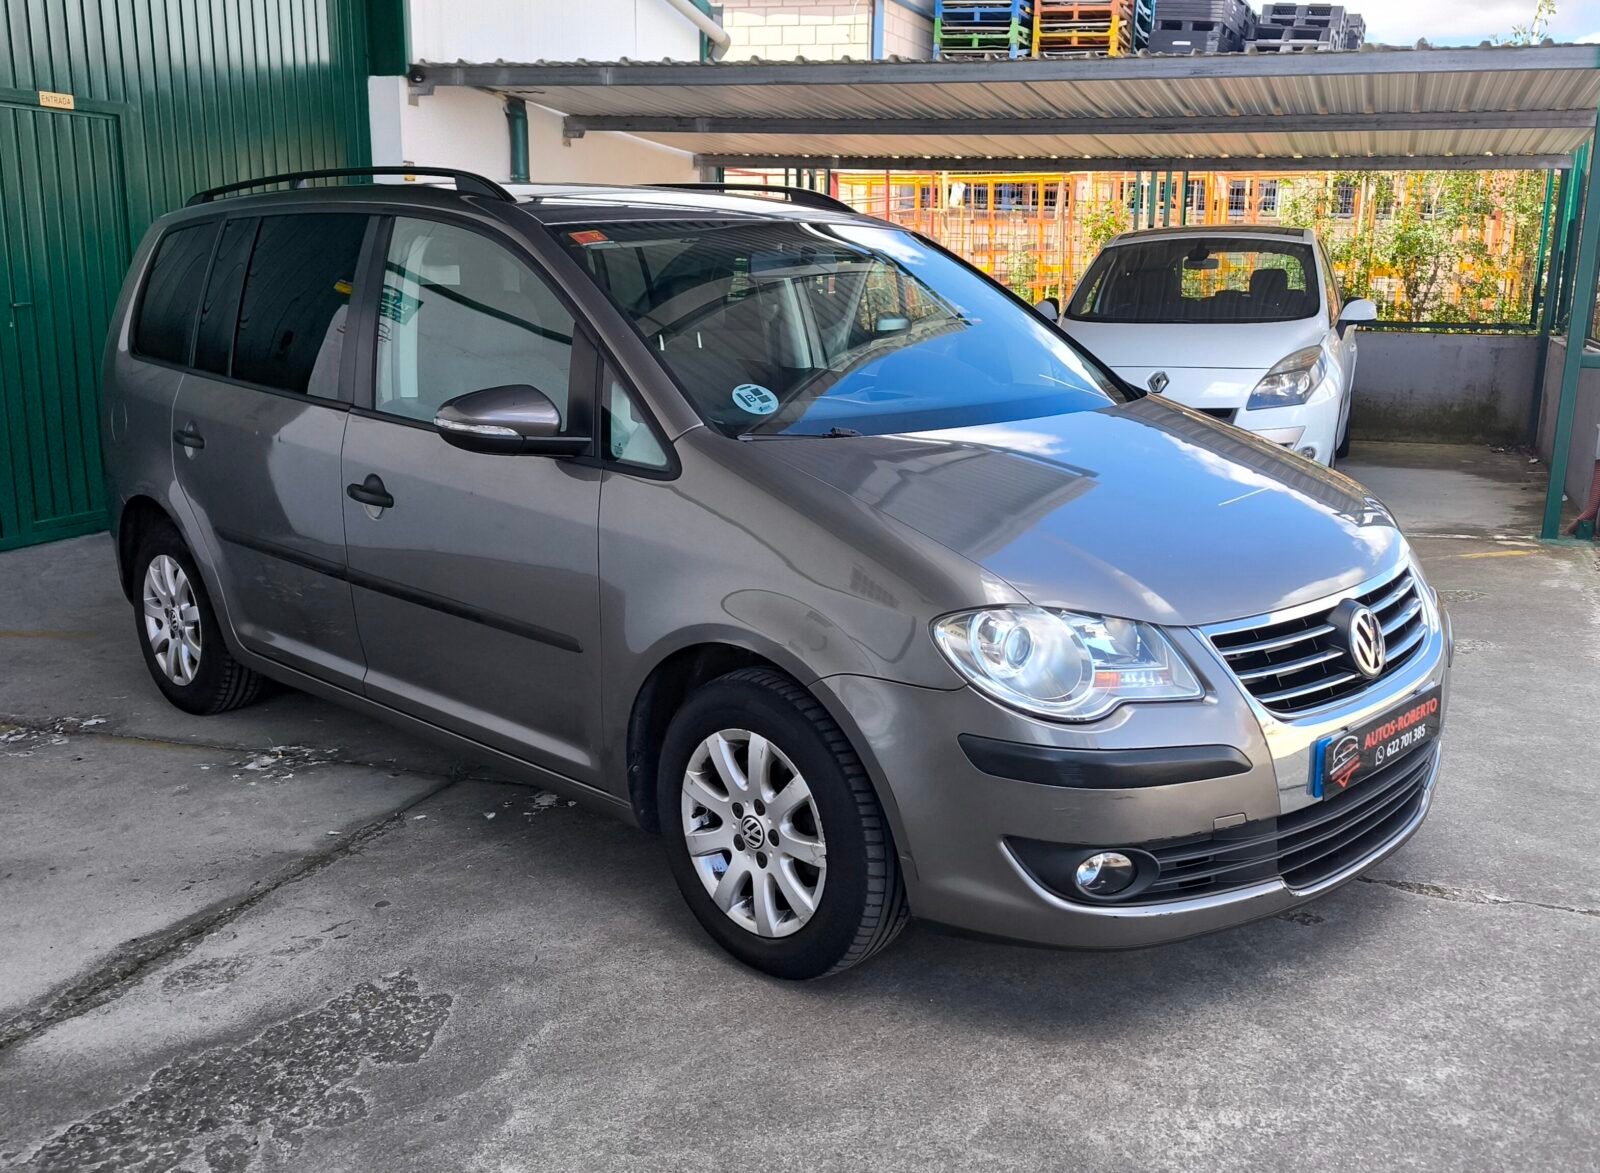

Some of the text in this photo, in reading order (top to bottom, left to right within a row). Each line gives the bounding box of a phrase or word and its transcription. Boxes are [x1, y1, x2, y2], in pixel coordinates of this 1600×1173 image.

[41, 95, 71, 105] ENTRADA
[1364, 698, 1438, 750] AUTOS-ROBERTO
[1386, 723, 1426, 757] 622 701 385
